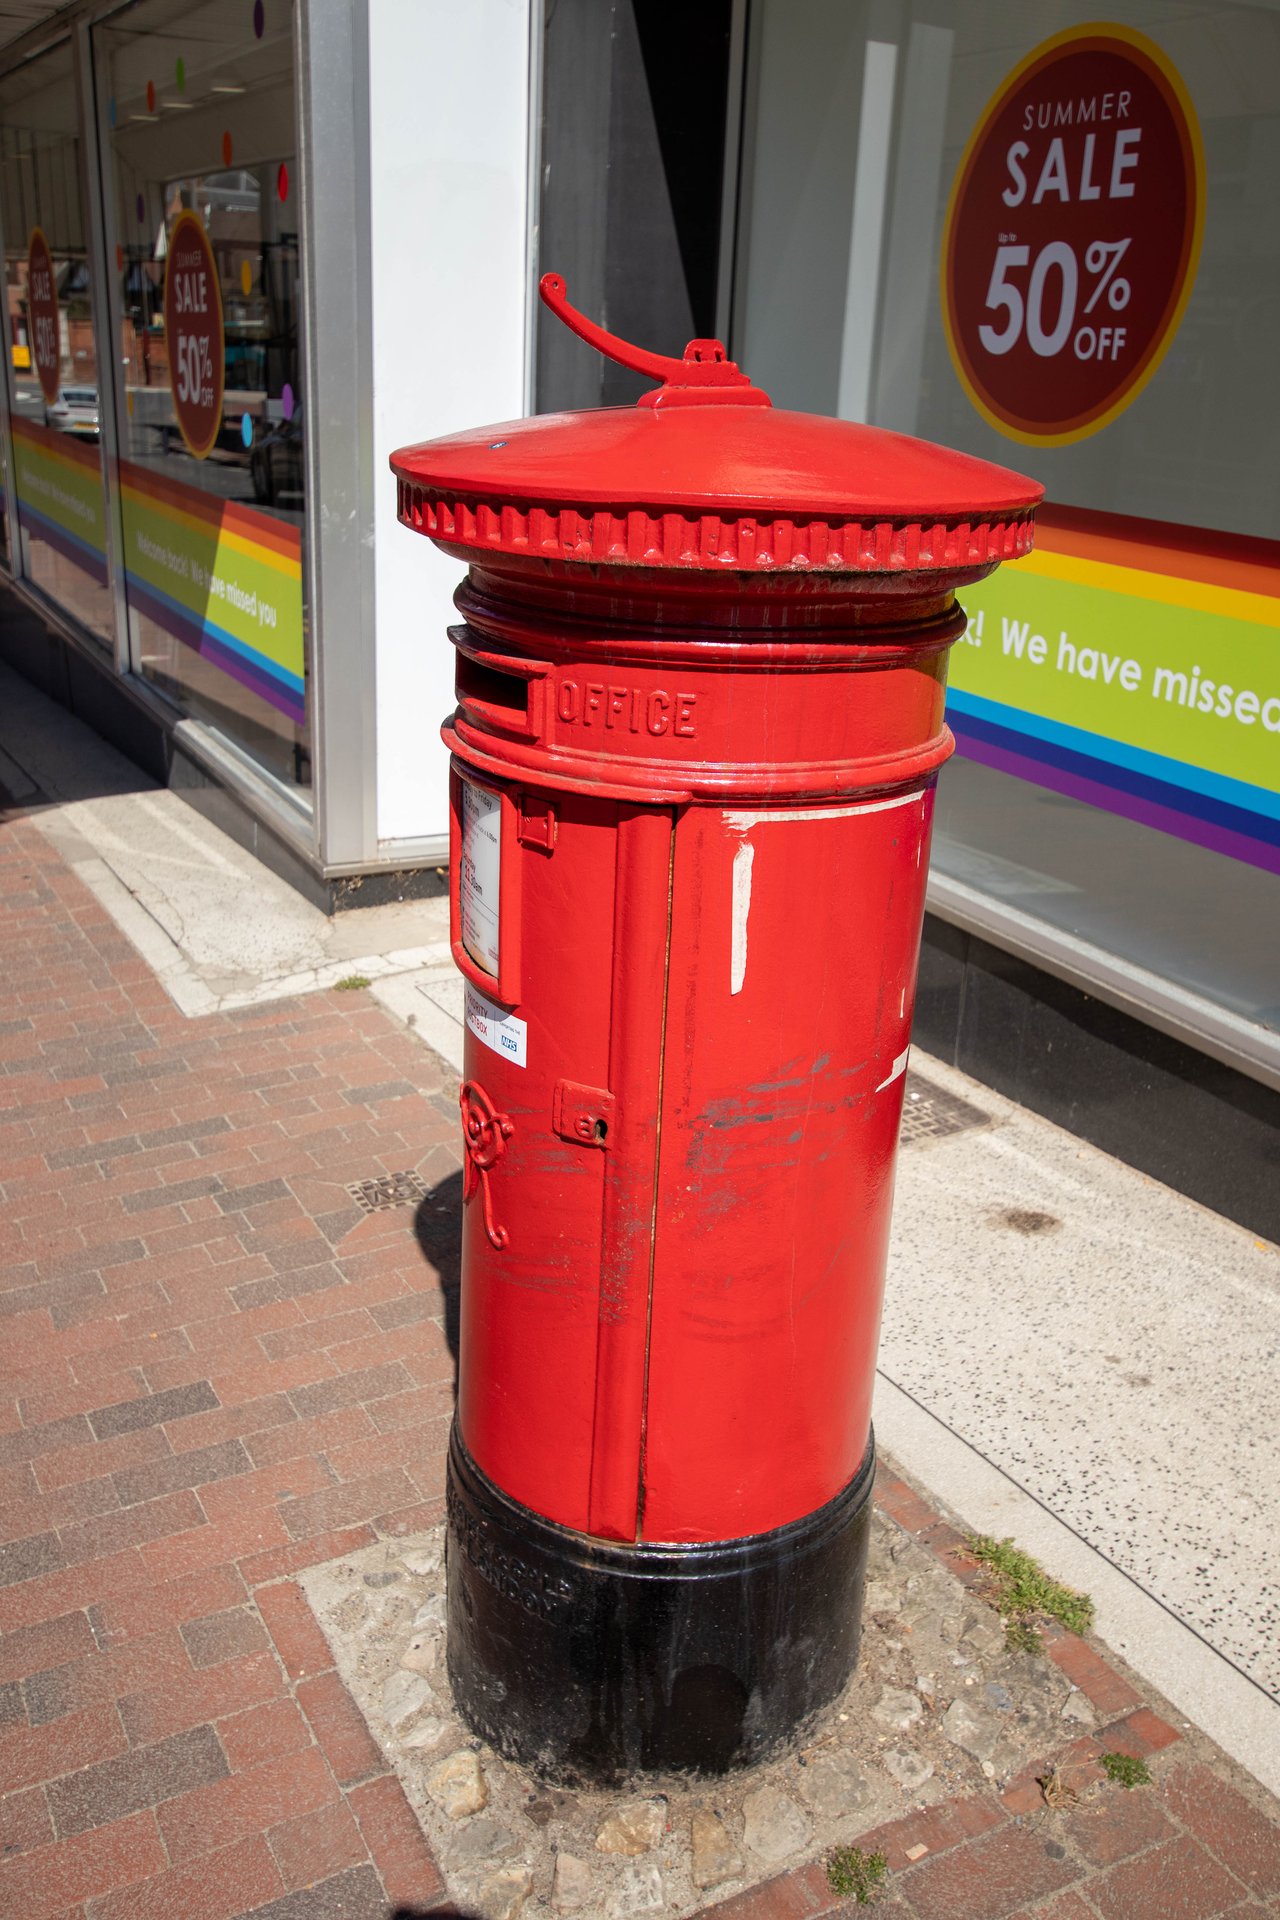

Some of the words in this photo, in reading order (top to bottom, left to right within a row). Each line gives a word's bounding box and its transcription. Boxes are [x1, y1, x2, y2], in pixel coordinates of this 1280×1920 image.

[1023, 91, 1131, 130] SUMMER
[1001, 128, 1142, 208] SALE
[32, 271, 51, 302] SALE
[174, 271, 208, 314] SALE
[978, 237, 1132, 357] 50%
[1073, 327, 1127, 361] OFF
[177, 335, 213, 404] 50%
[201, 386, 214, 408] OFF
[203, 565, 225, 598] have
[226, 580, 257, 618] missed
[258, 600, 277, 628] you
[958, 606, 985, 648] k!
[1001, 617, 1048, 665] We
[1056, 631, 1142, 692] have
[558, 679, 698, 739] OFFICE
[478, 790, 493, 811] Friday
[501, 1035, 517, 1052] NHS
